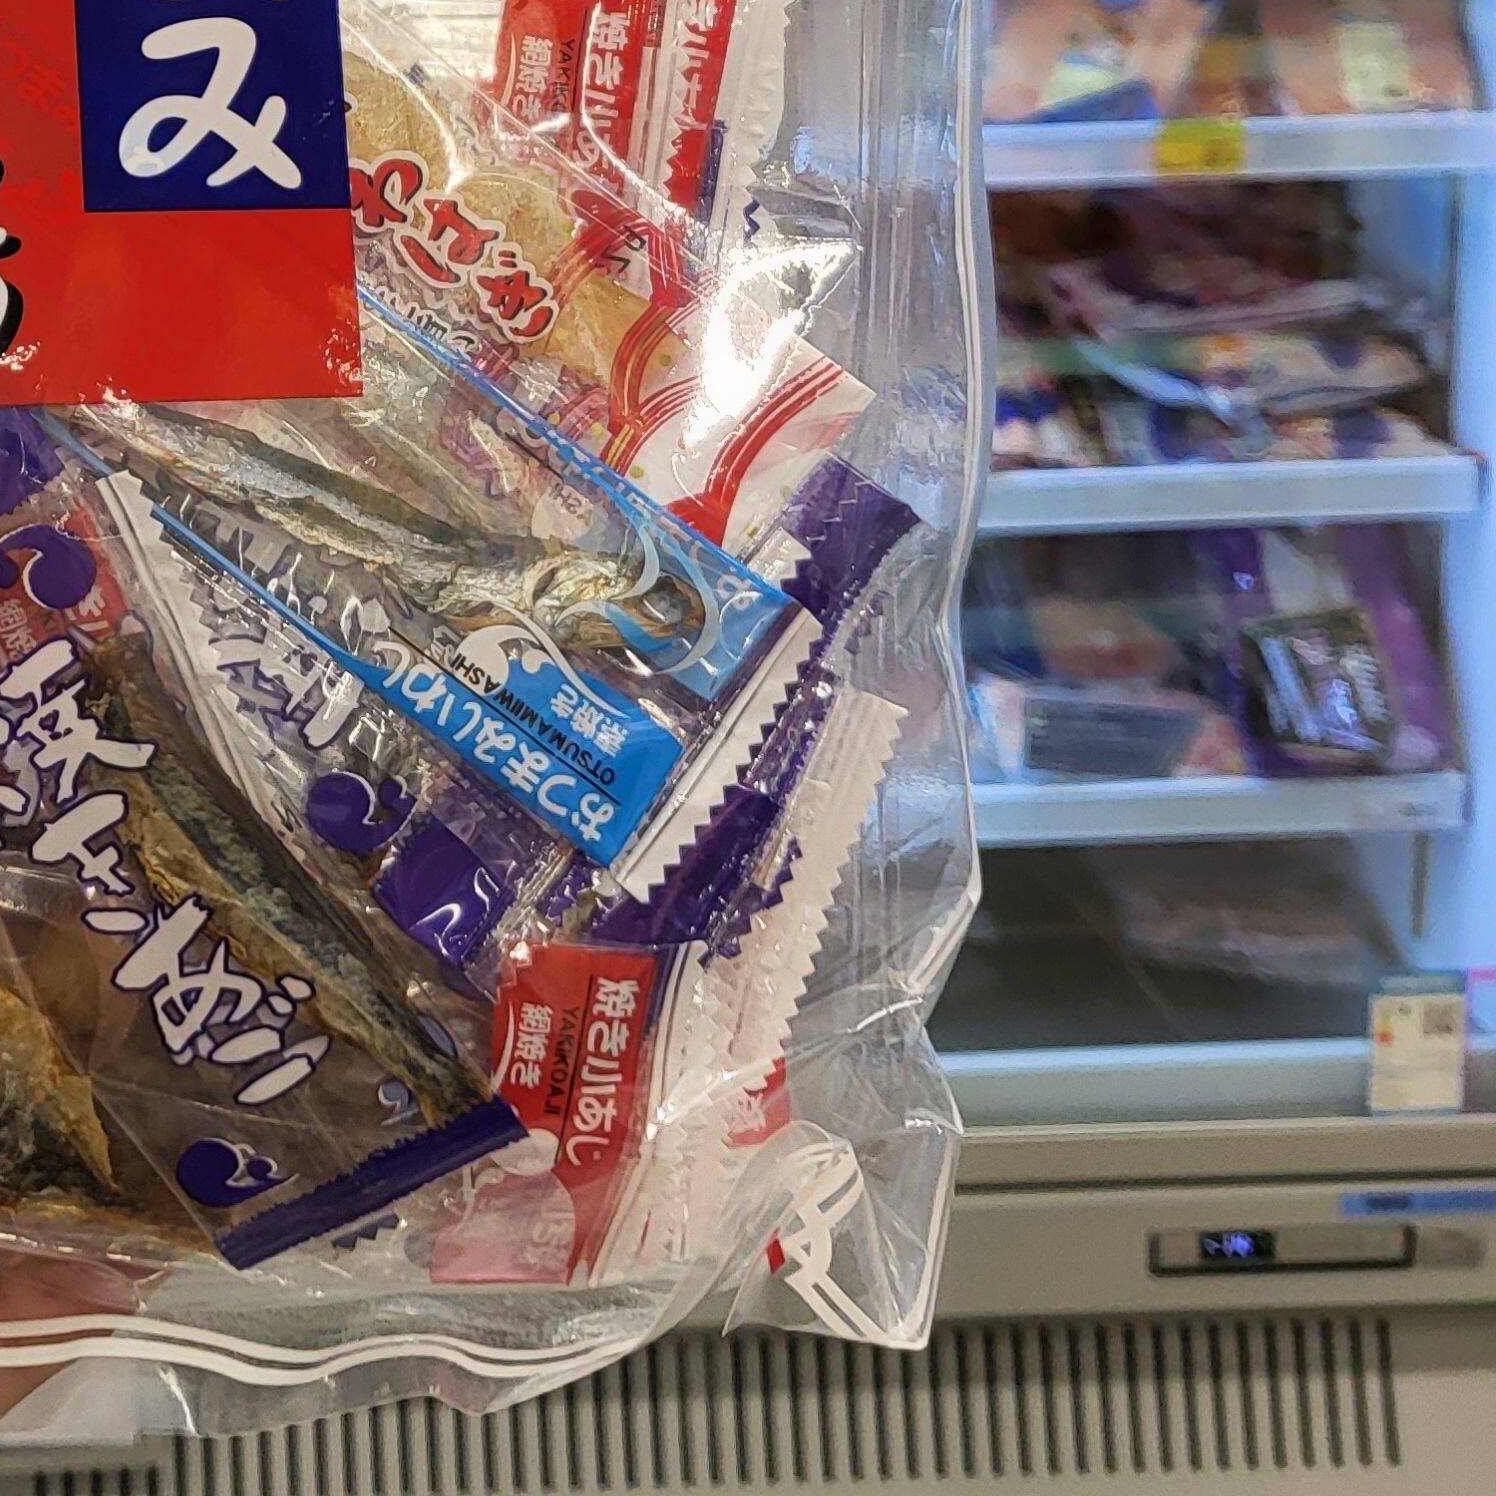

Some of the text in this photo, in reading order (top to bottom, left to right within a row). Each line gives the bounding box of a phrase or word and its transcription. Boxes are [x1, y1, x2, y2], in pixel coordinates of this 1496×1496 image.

[378, 640, 615, 846] おつまみいわし
[456, 655, 617, 788] OTSUMAMIIWASHI
[549, 683, 631, 756] 素焼き
[510, 1000, 554, 1091] 網焼き
[541, 1006, 582, 1120] YAKIKOAJI
[558, 975, 643, 1169] 焼き小あじ
